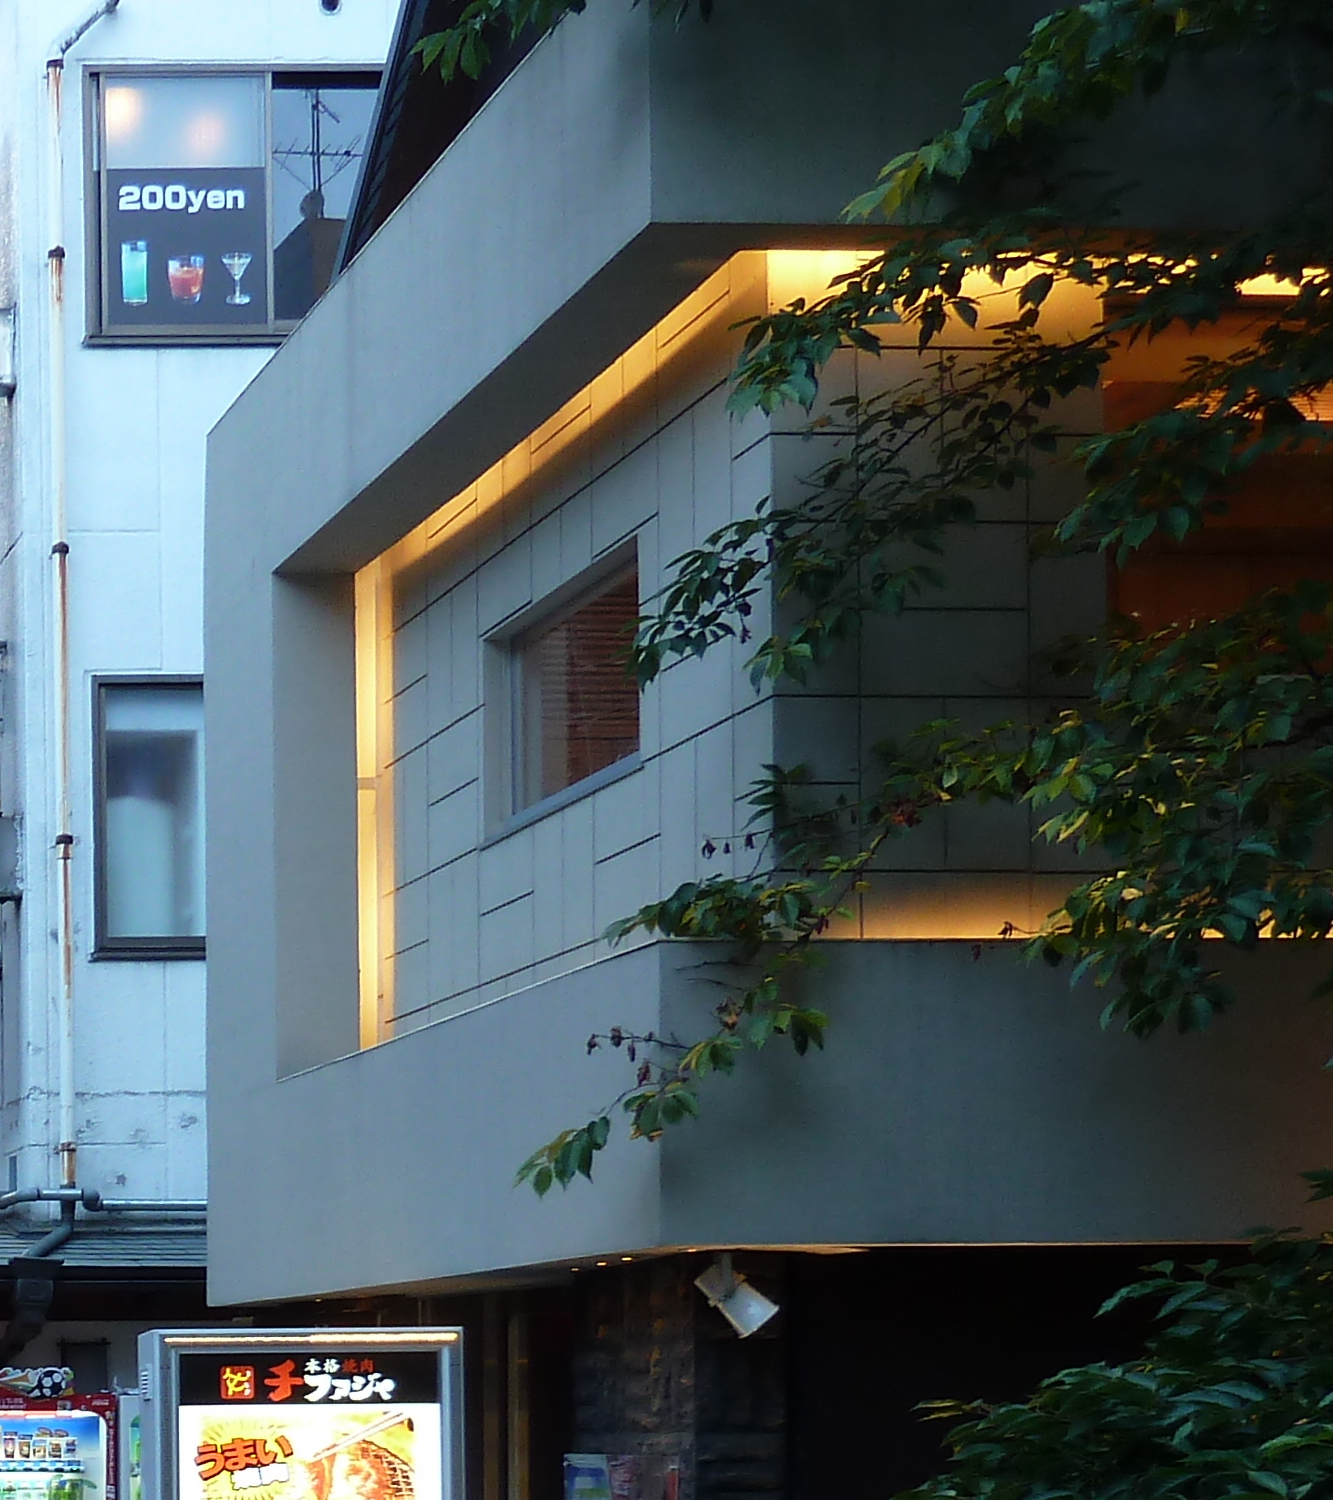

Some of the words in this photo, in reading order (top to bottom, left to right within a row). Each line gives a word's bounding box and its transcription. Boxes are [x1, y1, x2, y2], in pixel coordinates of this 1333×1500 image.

[118, 185, 245, 213] 200yen
[194, 1434, 294, 1481] うまい
